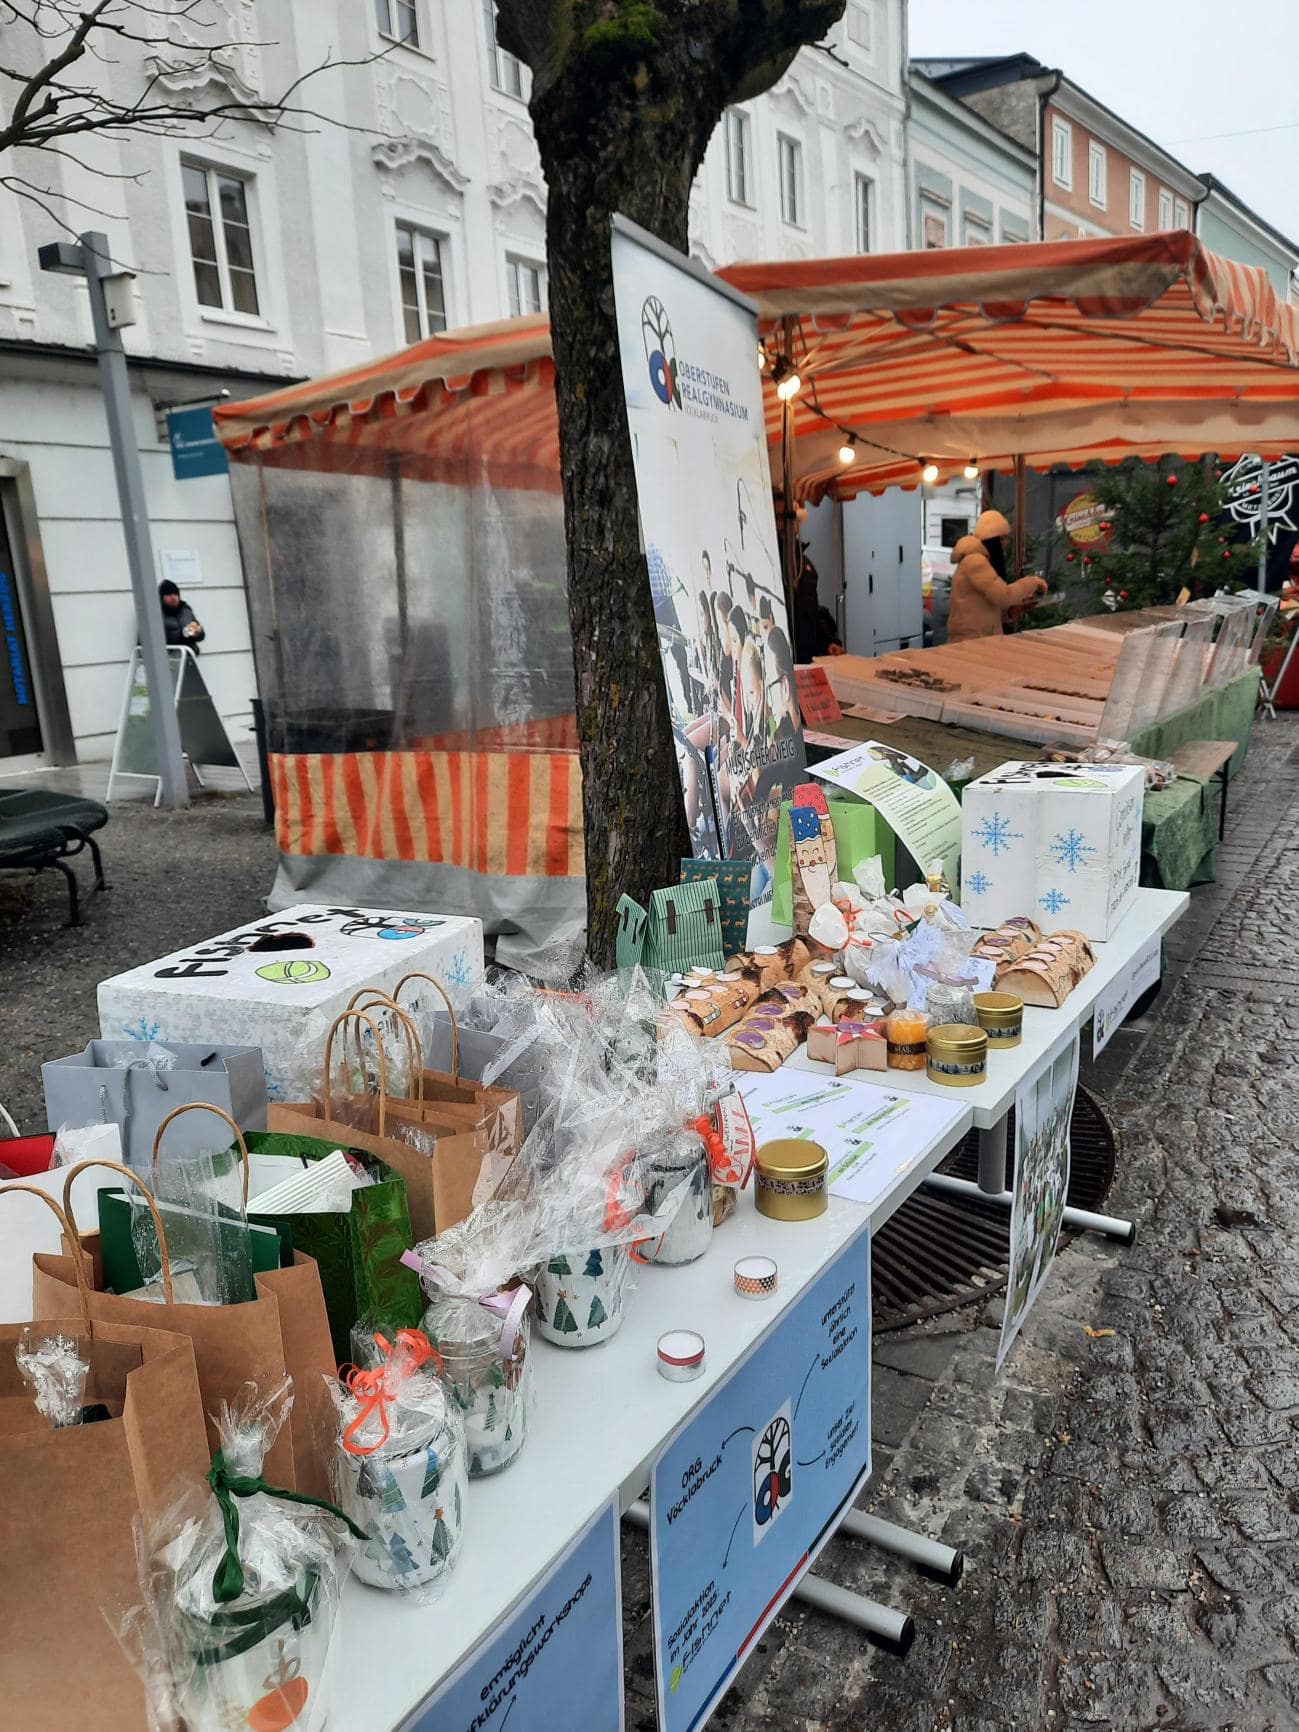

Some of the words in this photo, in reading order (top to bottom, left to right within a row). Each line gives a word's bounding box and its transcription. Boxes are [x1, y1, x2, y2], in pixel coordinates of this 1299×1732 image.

[679, 361, 730, 395] OBERSTUFEN
[682, 383, 749, 421] REALGYMNASIUM
[821, 1282, 856, 1326] unterstützt
[820, 1326, 858, 1371] Sozialaktion
[832, 1326, 847, 1346] eine
[667, 1454, 722, 1527] Vöcklabruck
[681, 1456, 702, 1489] ORG
[667, 1580, 715, 1650] Sozialaktion
[466, 1572, 592, 1732] fklärungsworkshops
[480, 1614, 546, 1701] ermöglicht
[670, 1645, 680, 1665] im
[682, 1616, 699, 1647] Jahr
